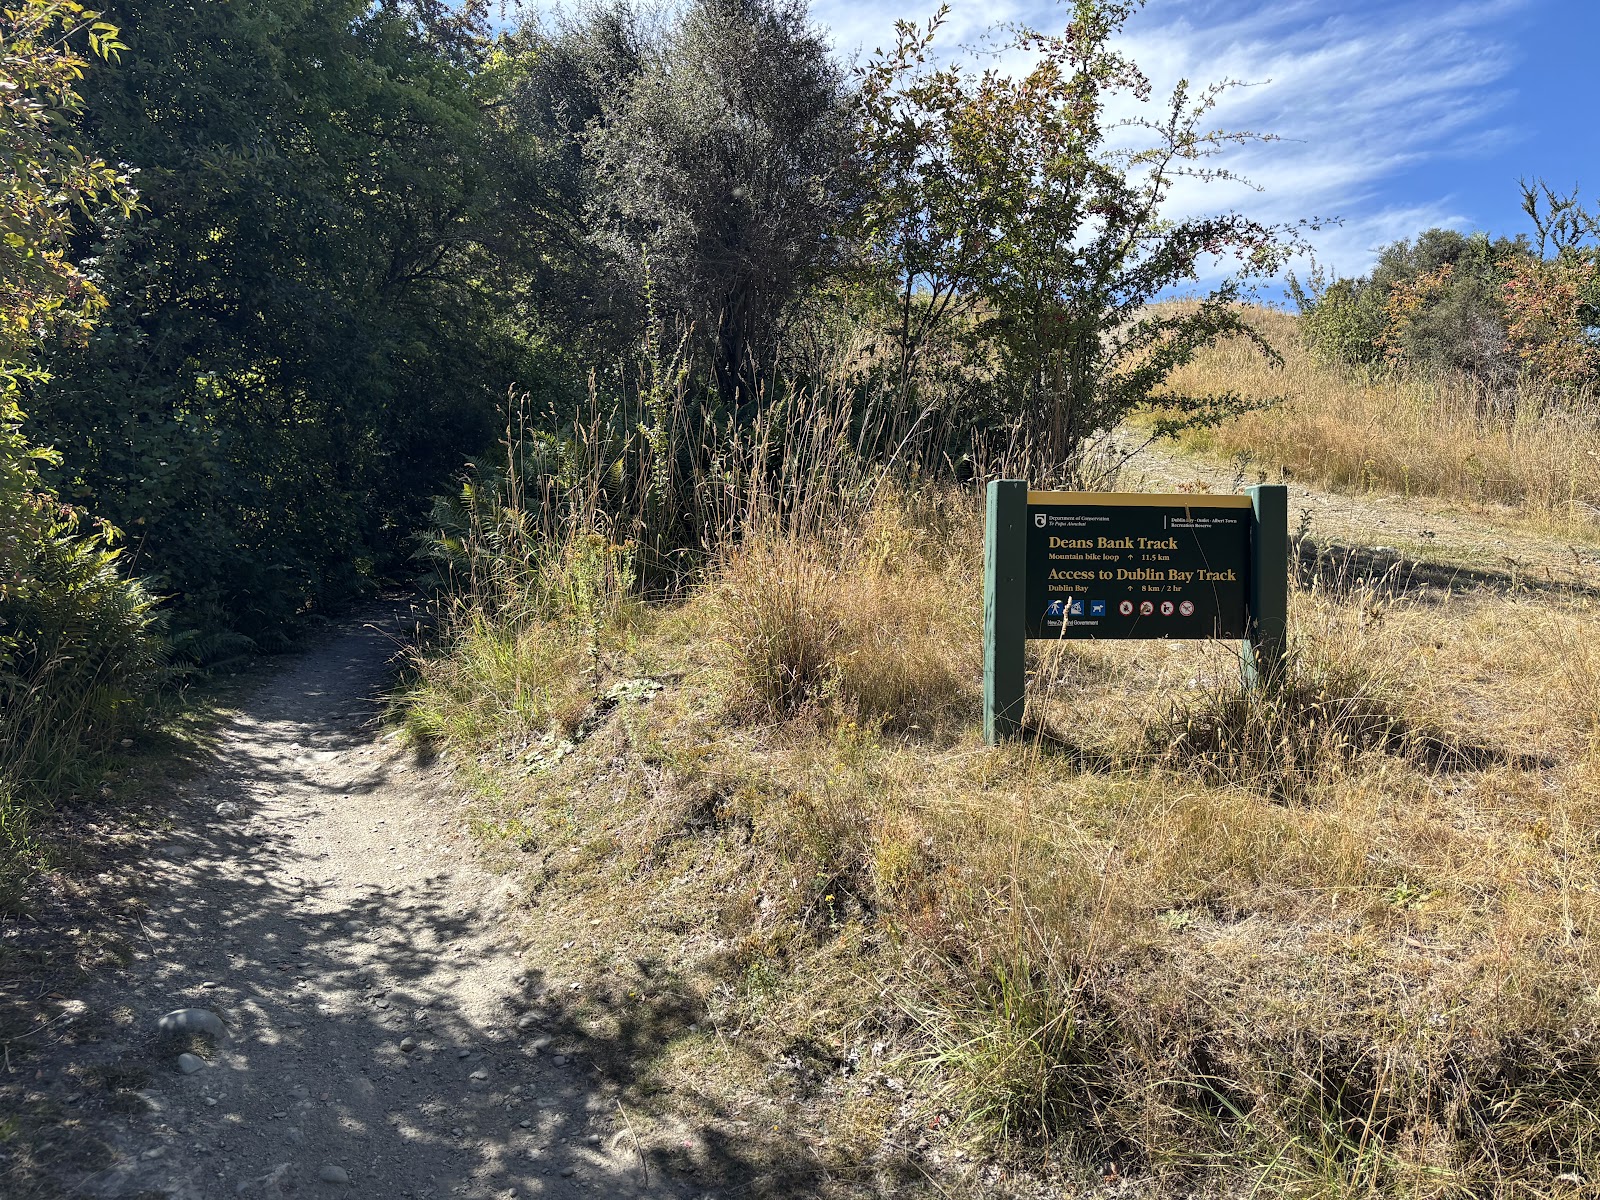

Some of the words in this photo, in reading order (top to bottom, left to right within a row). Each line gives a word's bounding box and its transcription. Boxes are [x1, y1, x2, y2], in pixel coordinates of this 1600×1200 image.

[1049, 536, 1093, 549] Deans
[1097, 537, 1134, 549] Bank
[1137, 537, 1178, 550] Track
[1103, 554, 1119, 562] loop
[1048, 568, 1095, 580] Access
[1099, 570, 1113, 580] to
[1117, 568, 1165, 581] Dublin
[1168, 569, 1194, 584] Bay
[1197, 569, 1236, 581] Track
[1075, 585, 1089, 593] Bay
[1161, 585, 1166, 593] /
